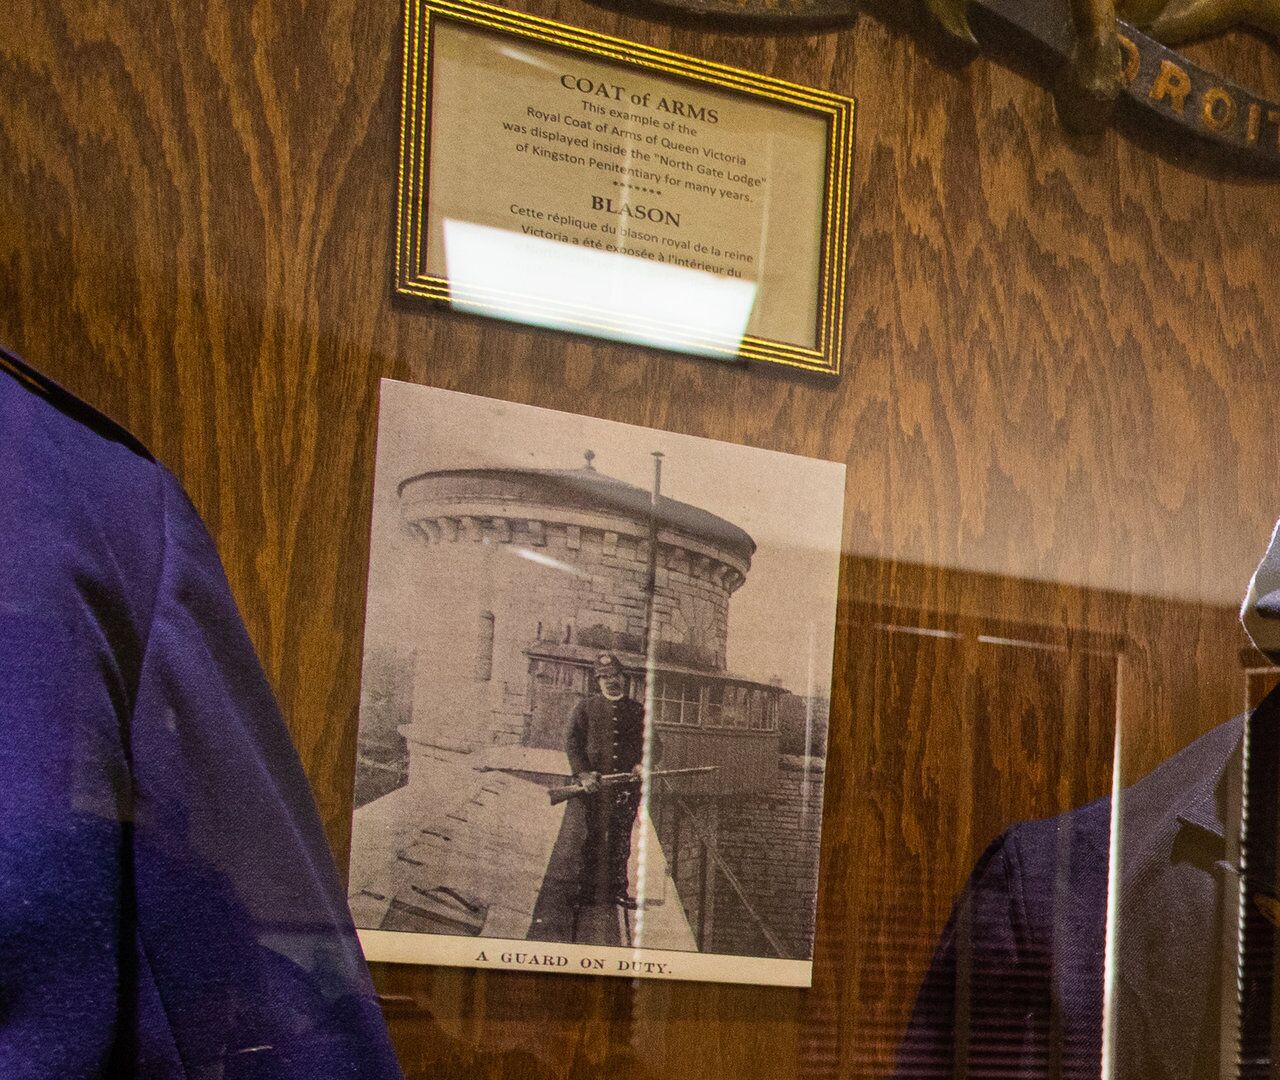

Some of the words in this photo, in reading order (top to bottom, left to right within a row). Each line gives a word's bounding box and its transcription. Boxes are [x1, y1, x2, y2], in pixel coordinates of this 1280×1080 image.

[561, 74, 625, 100] COAT
[631, 93, 650, 107] of
[656, 97, 718, 124] ARMS
[582, 100, 606, 116] This
[609, 109, 660, 127] example
[663, 121, 676, 131] of
[678, 124, 697, 136] the
[502, 122, 527, 134] was
[531, 126, 589, 148] displayed
[593, 140, 627, 156] inside
[631, 149, 651, 162] the
[654, 153, 693, 172] "North
[696, 164, 724, 179] Gate
[727, 171, 767, 188] Lodge"
[527, 106, 561, 122] Royal
[564, 115, 592, 130] Coat
[596, 124, 608, 133] of
[611, 126, 642, 141] Arms
[645, 135, 658, 145] of
[661, 137, 699, 155] Queen
[703, 147, 747, 166] Victoria
[516, 143, 529, 153] of
[532, 146, 586, 166] Kingston
[589, 157, 661, 182] Penitentiary
[664, 173, 681, 186] for
[685, 180, 717, 196] many
[719, 188, 753, 203] years.
[510, 203, 544, 220] Cette
[547, 213, 597, 230] réplique
[601, 223, 616, 234] du
[620, 226, 658, 243] blason
[662, 236, 691, 250] royal
[693, 243, 709, 254] de
[711, 245, 721, 257] la
[724, 249, 753, 263] reine
[592, 195, 681, 227] BLASON
[521, 224, 569, 243] Victoria
[571, 237, 579, 245] a
[583, 237, 602, 250] été
[658, 252, 665, 262] à
[668, 253, 725, 275] l'intérieur
[727, 267, 742, 278] du
[476, 951, 489, 962] A
[501, 952, 569, 967] GUARD
[580, 957, 607, 970] ON
[618, 960, 673, 975] DUTY.
